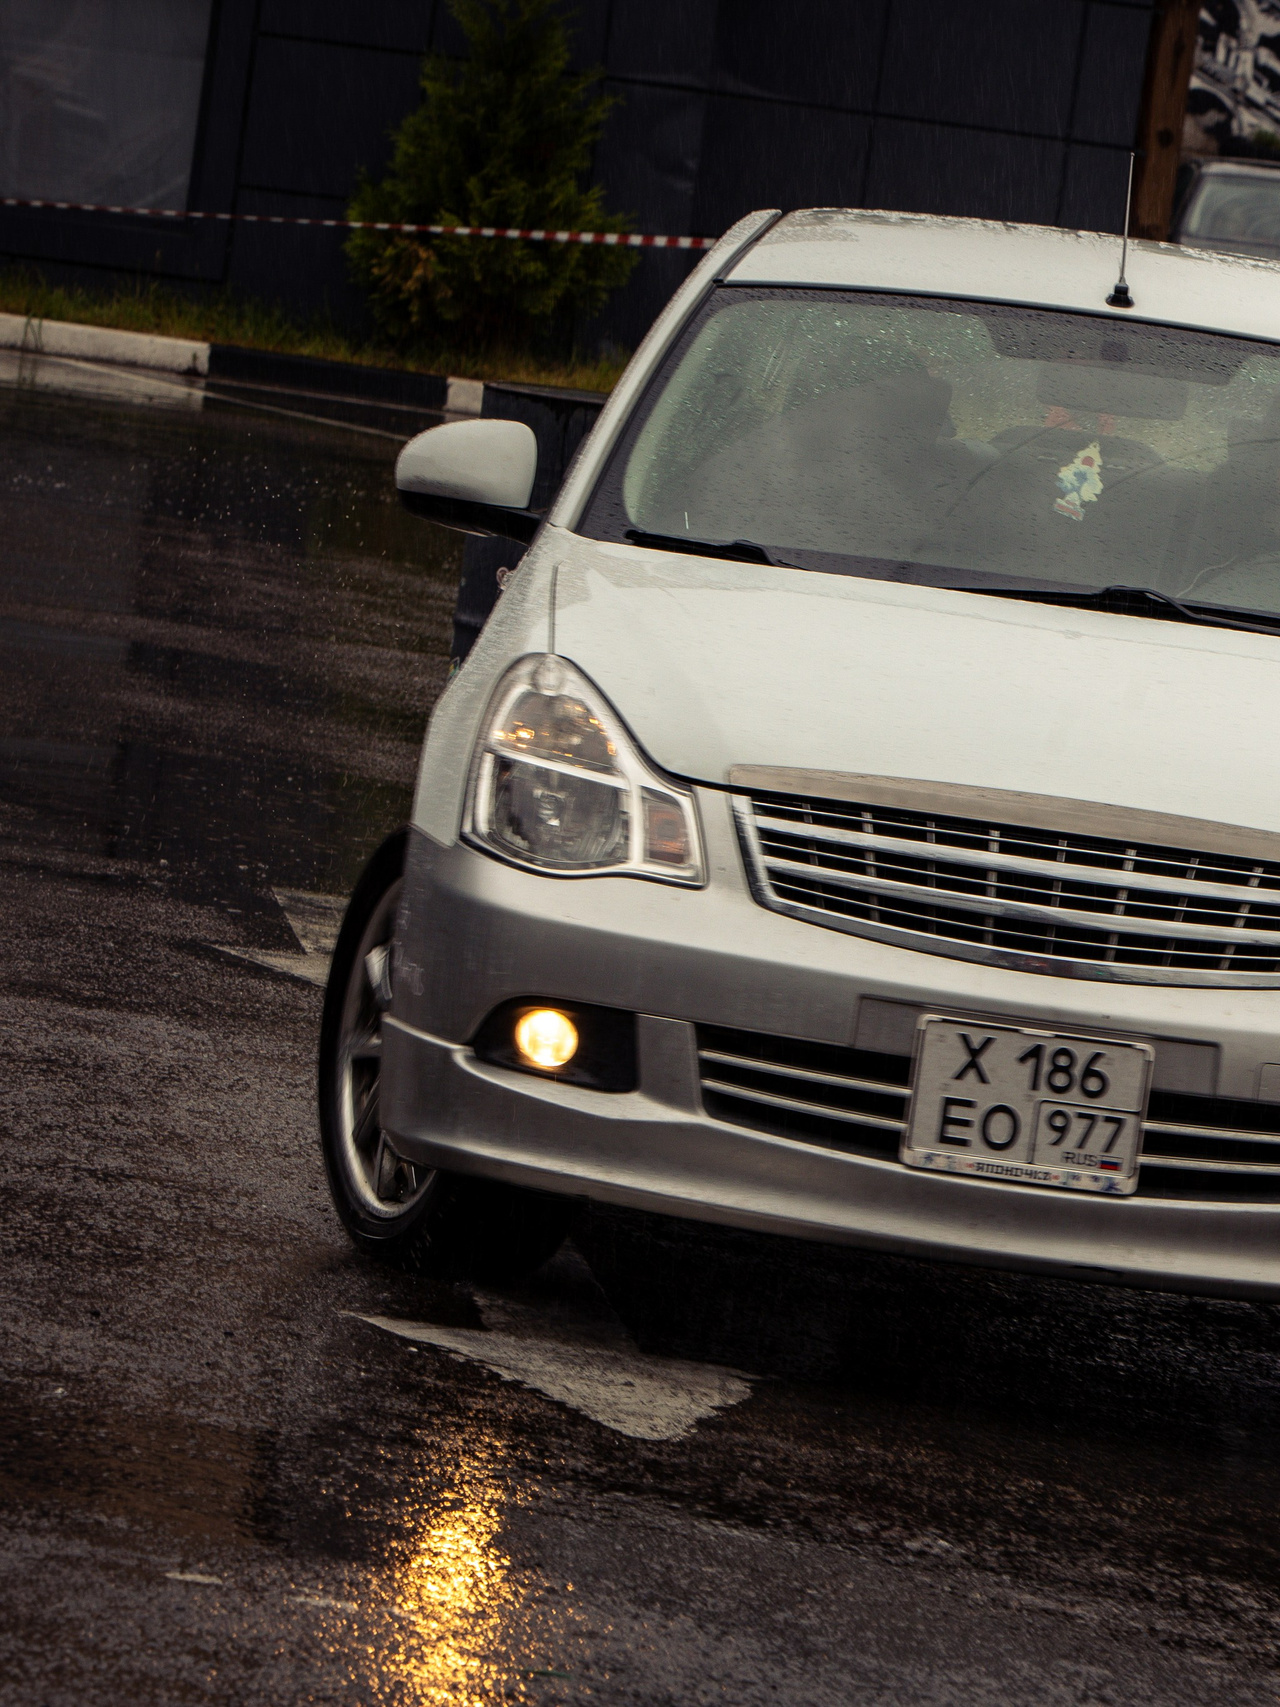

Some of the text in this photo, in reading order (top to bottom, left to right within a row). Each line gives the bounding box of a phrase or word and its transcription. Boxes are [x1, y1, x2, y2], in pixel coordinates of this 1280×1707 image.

[1016, 1042, 1111, 1099] 186
[1047, 1108, 1128, 1153] 977
[1061, 1150, 1099, 1168] RUS
